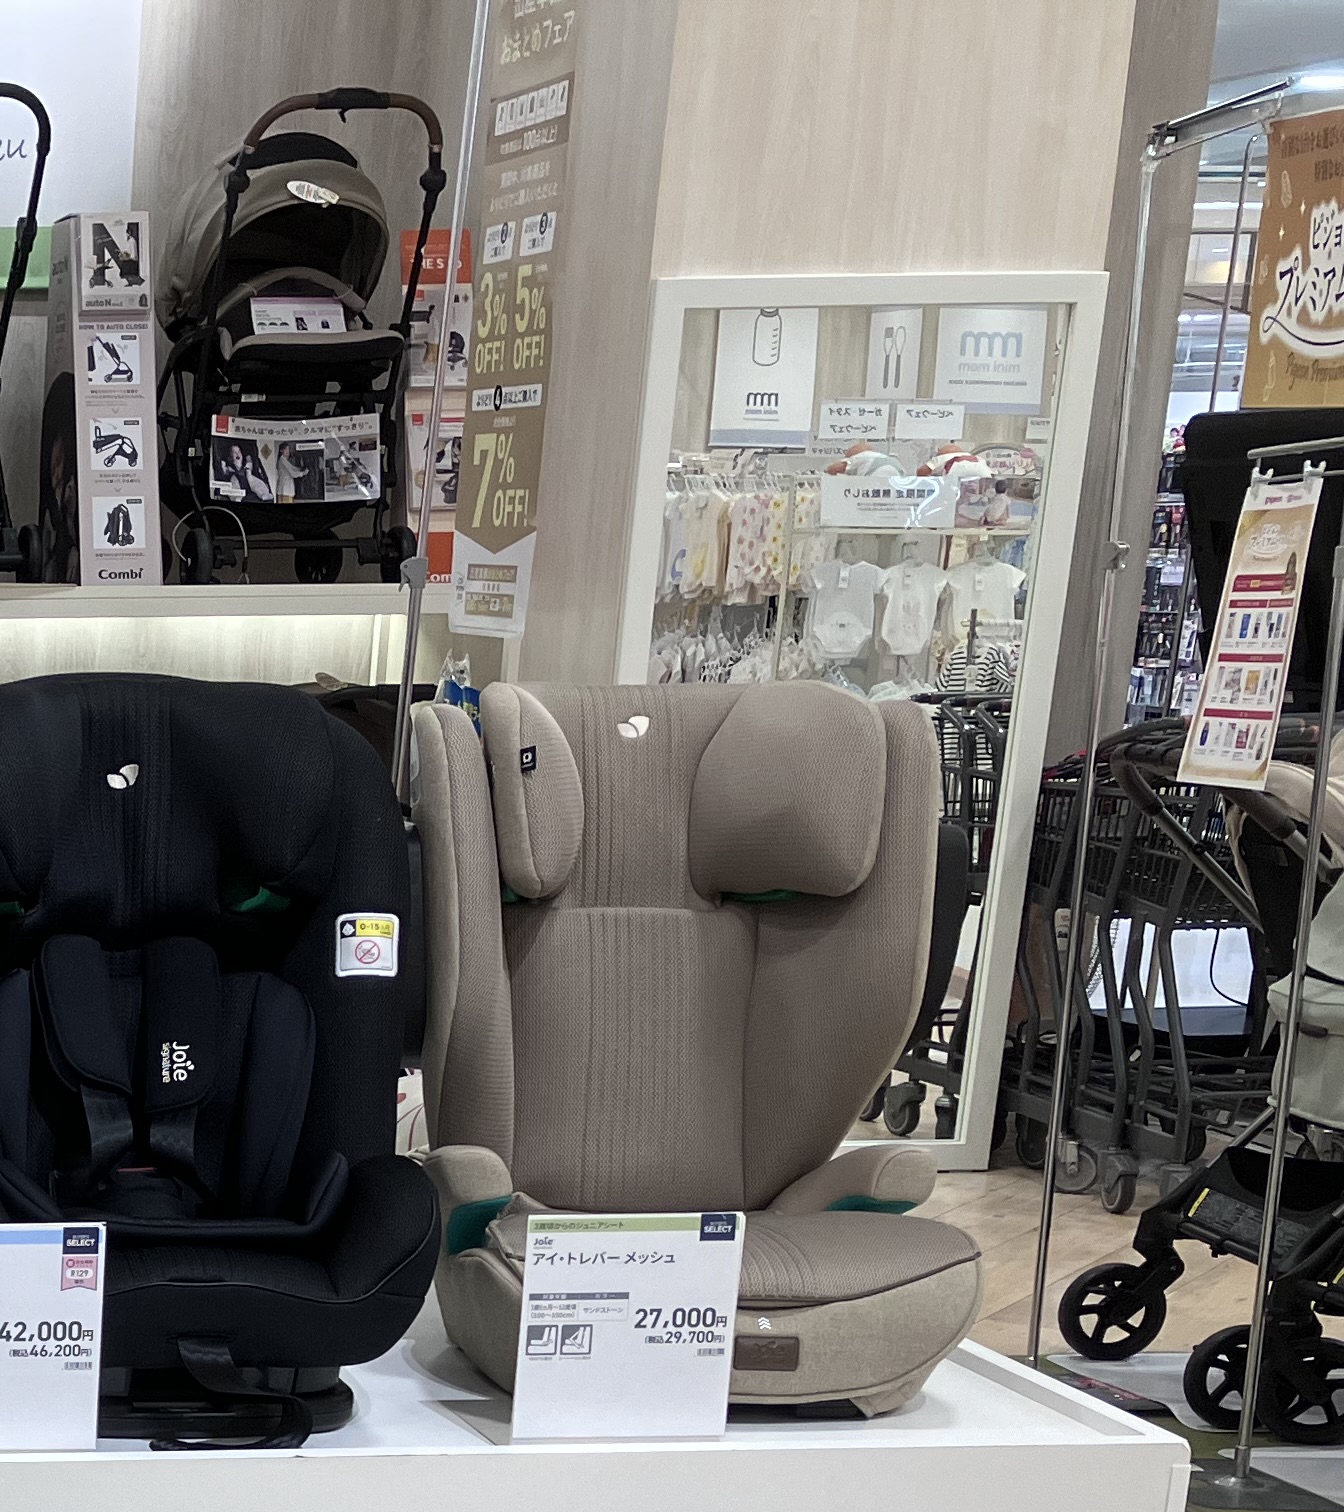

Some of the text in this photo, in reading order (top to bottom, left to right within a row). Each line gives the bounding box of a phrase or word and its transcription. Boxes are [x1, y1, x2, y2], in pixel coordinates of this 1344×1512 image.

[475, 340, 505, 374] OFF!
[513, 335, 545, 370] OFF!
[492, 489, 529, 527] OFF!
[98, 567, 144, 580] Combi
[172, 1041, 195, 1082] Joie
[703, 1224, 733, 1234] SELECT
[66, 1239, 95, 1247] SELECT
[533, 1236, 554, 1246] Joie
[623, 1251, 676, 1265] メッシュ
[633, 1307, 728, 1329] 27,000円
